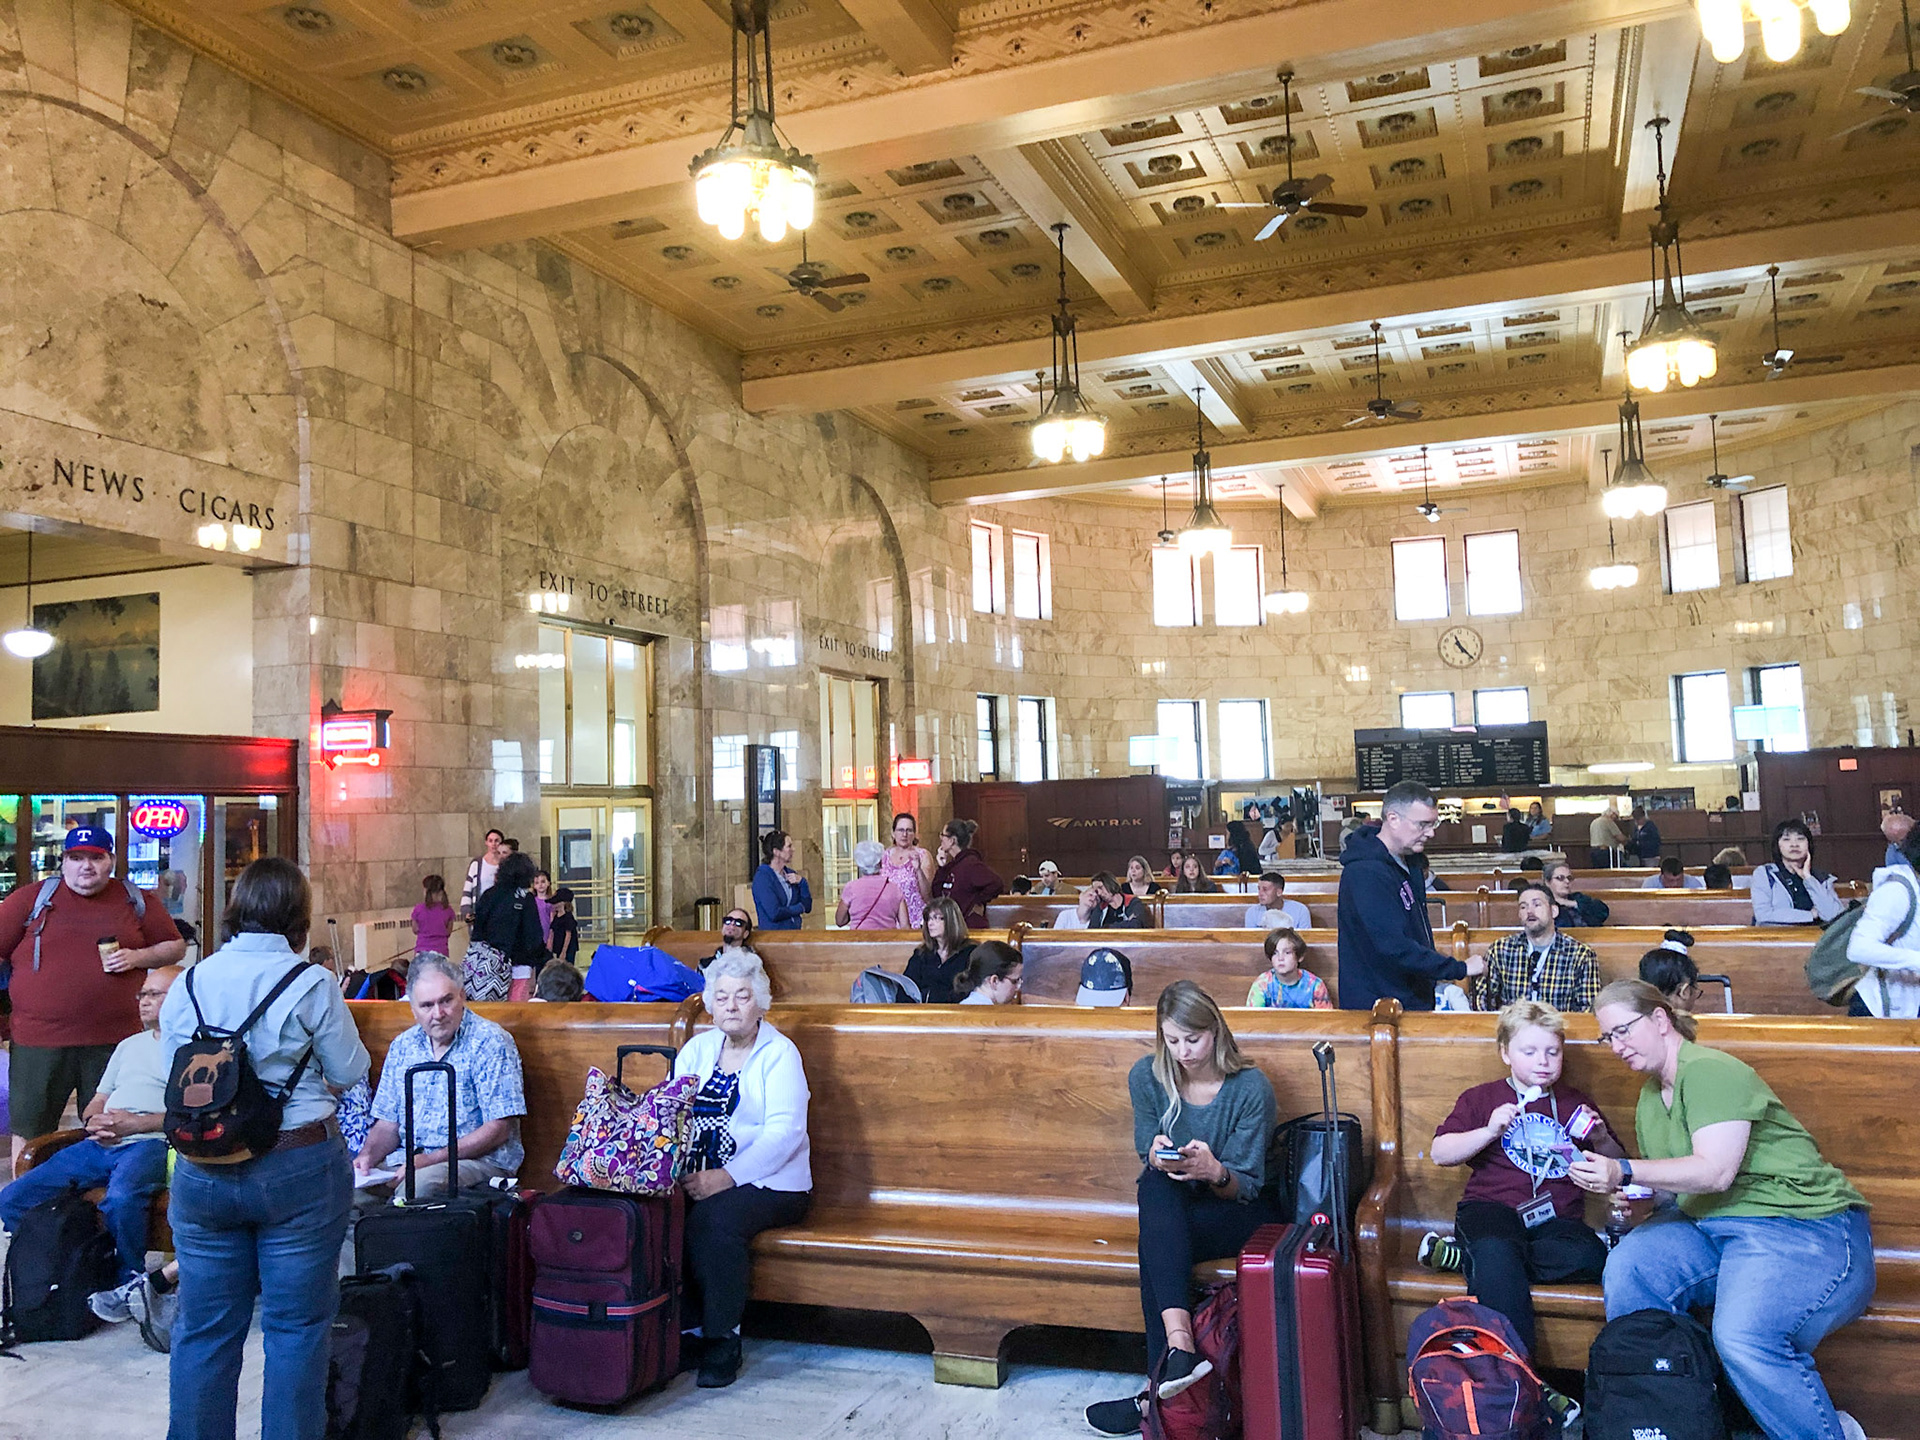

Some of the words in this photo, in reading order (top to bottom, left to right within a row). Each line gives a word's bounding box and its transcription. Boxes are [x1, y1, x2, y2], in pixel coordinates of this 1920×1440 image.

[52, 457, 145, 503] NEWS
[178, 487, 276, 532] CIGARS
[539, 570, 576, 596] EXIT
[588, 580, 609, 603] TO
[621, 589, 670, 616] STREET
[819, 635, 838, 652] EXIT
[844, 641, 856, 657] TO
[862, 645, 889, 663] STREET
[134, 806, 185, 829] OPEN
[1073, 817, 1143, 828] AMTRAK
[76, 829, 92, 842] T
